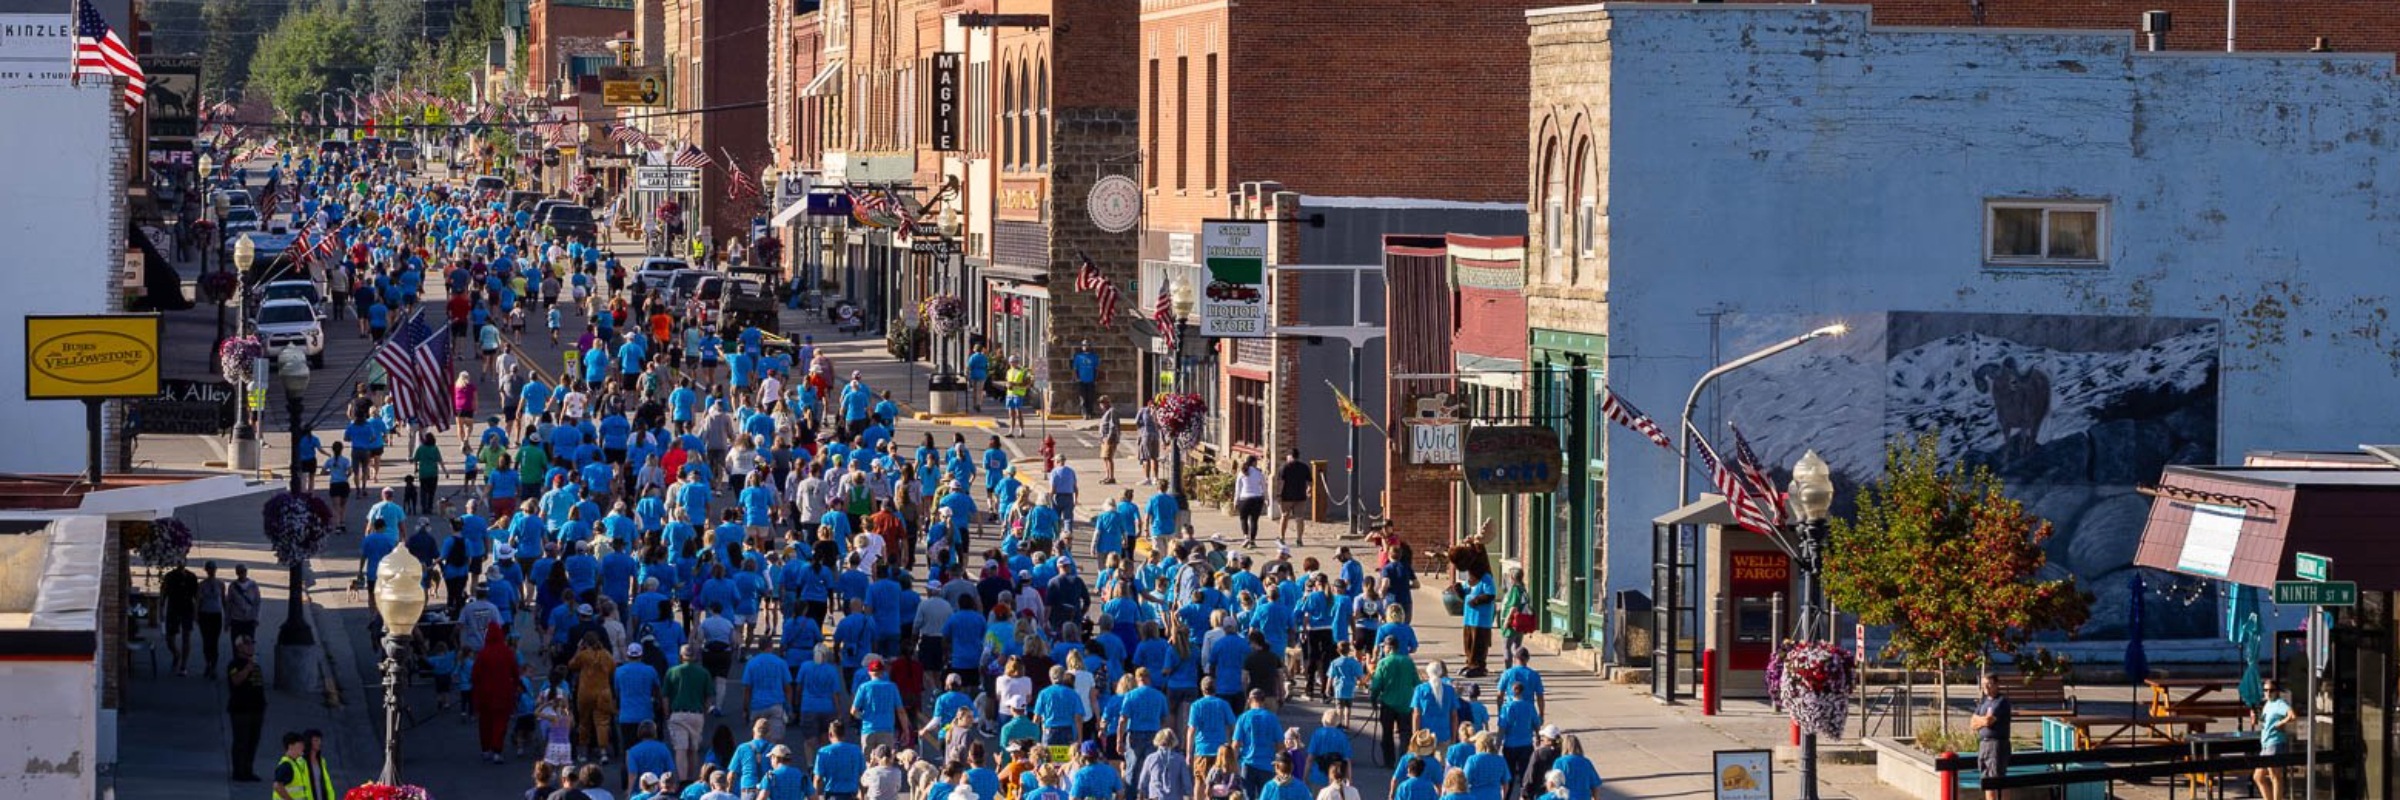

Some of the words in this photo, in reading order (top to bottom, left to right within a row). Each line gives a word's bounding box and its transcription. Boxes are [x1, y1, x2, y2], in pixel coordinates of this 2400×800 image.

[939, 55, 953, 149] MAGPIE
[1218, 226, 1251, 236] STATE
[1206, 246, 1263, 256] MONTANA
[1206, 304, 1261, 318] LIQUOR
[1211, 320, 1256, 332] STORE
[44, 350, 143, 369] YELLOWSTONE
[183, 382, 232, 405] Alley
[1416, 425, 1457, 449] Wild
[1416, 450, 1459, 462] TABLE
[1734, 555, 1787, 567] WELLS
[1734, 567, 1787, 579] FARGO
[2281, 585, 2318, 602] NINTH
[2325, 589, 2335, 601] ST
[2342, 590, 2349, 599] W
